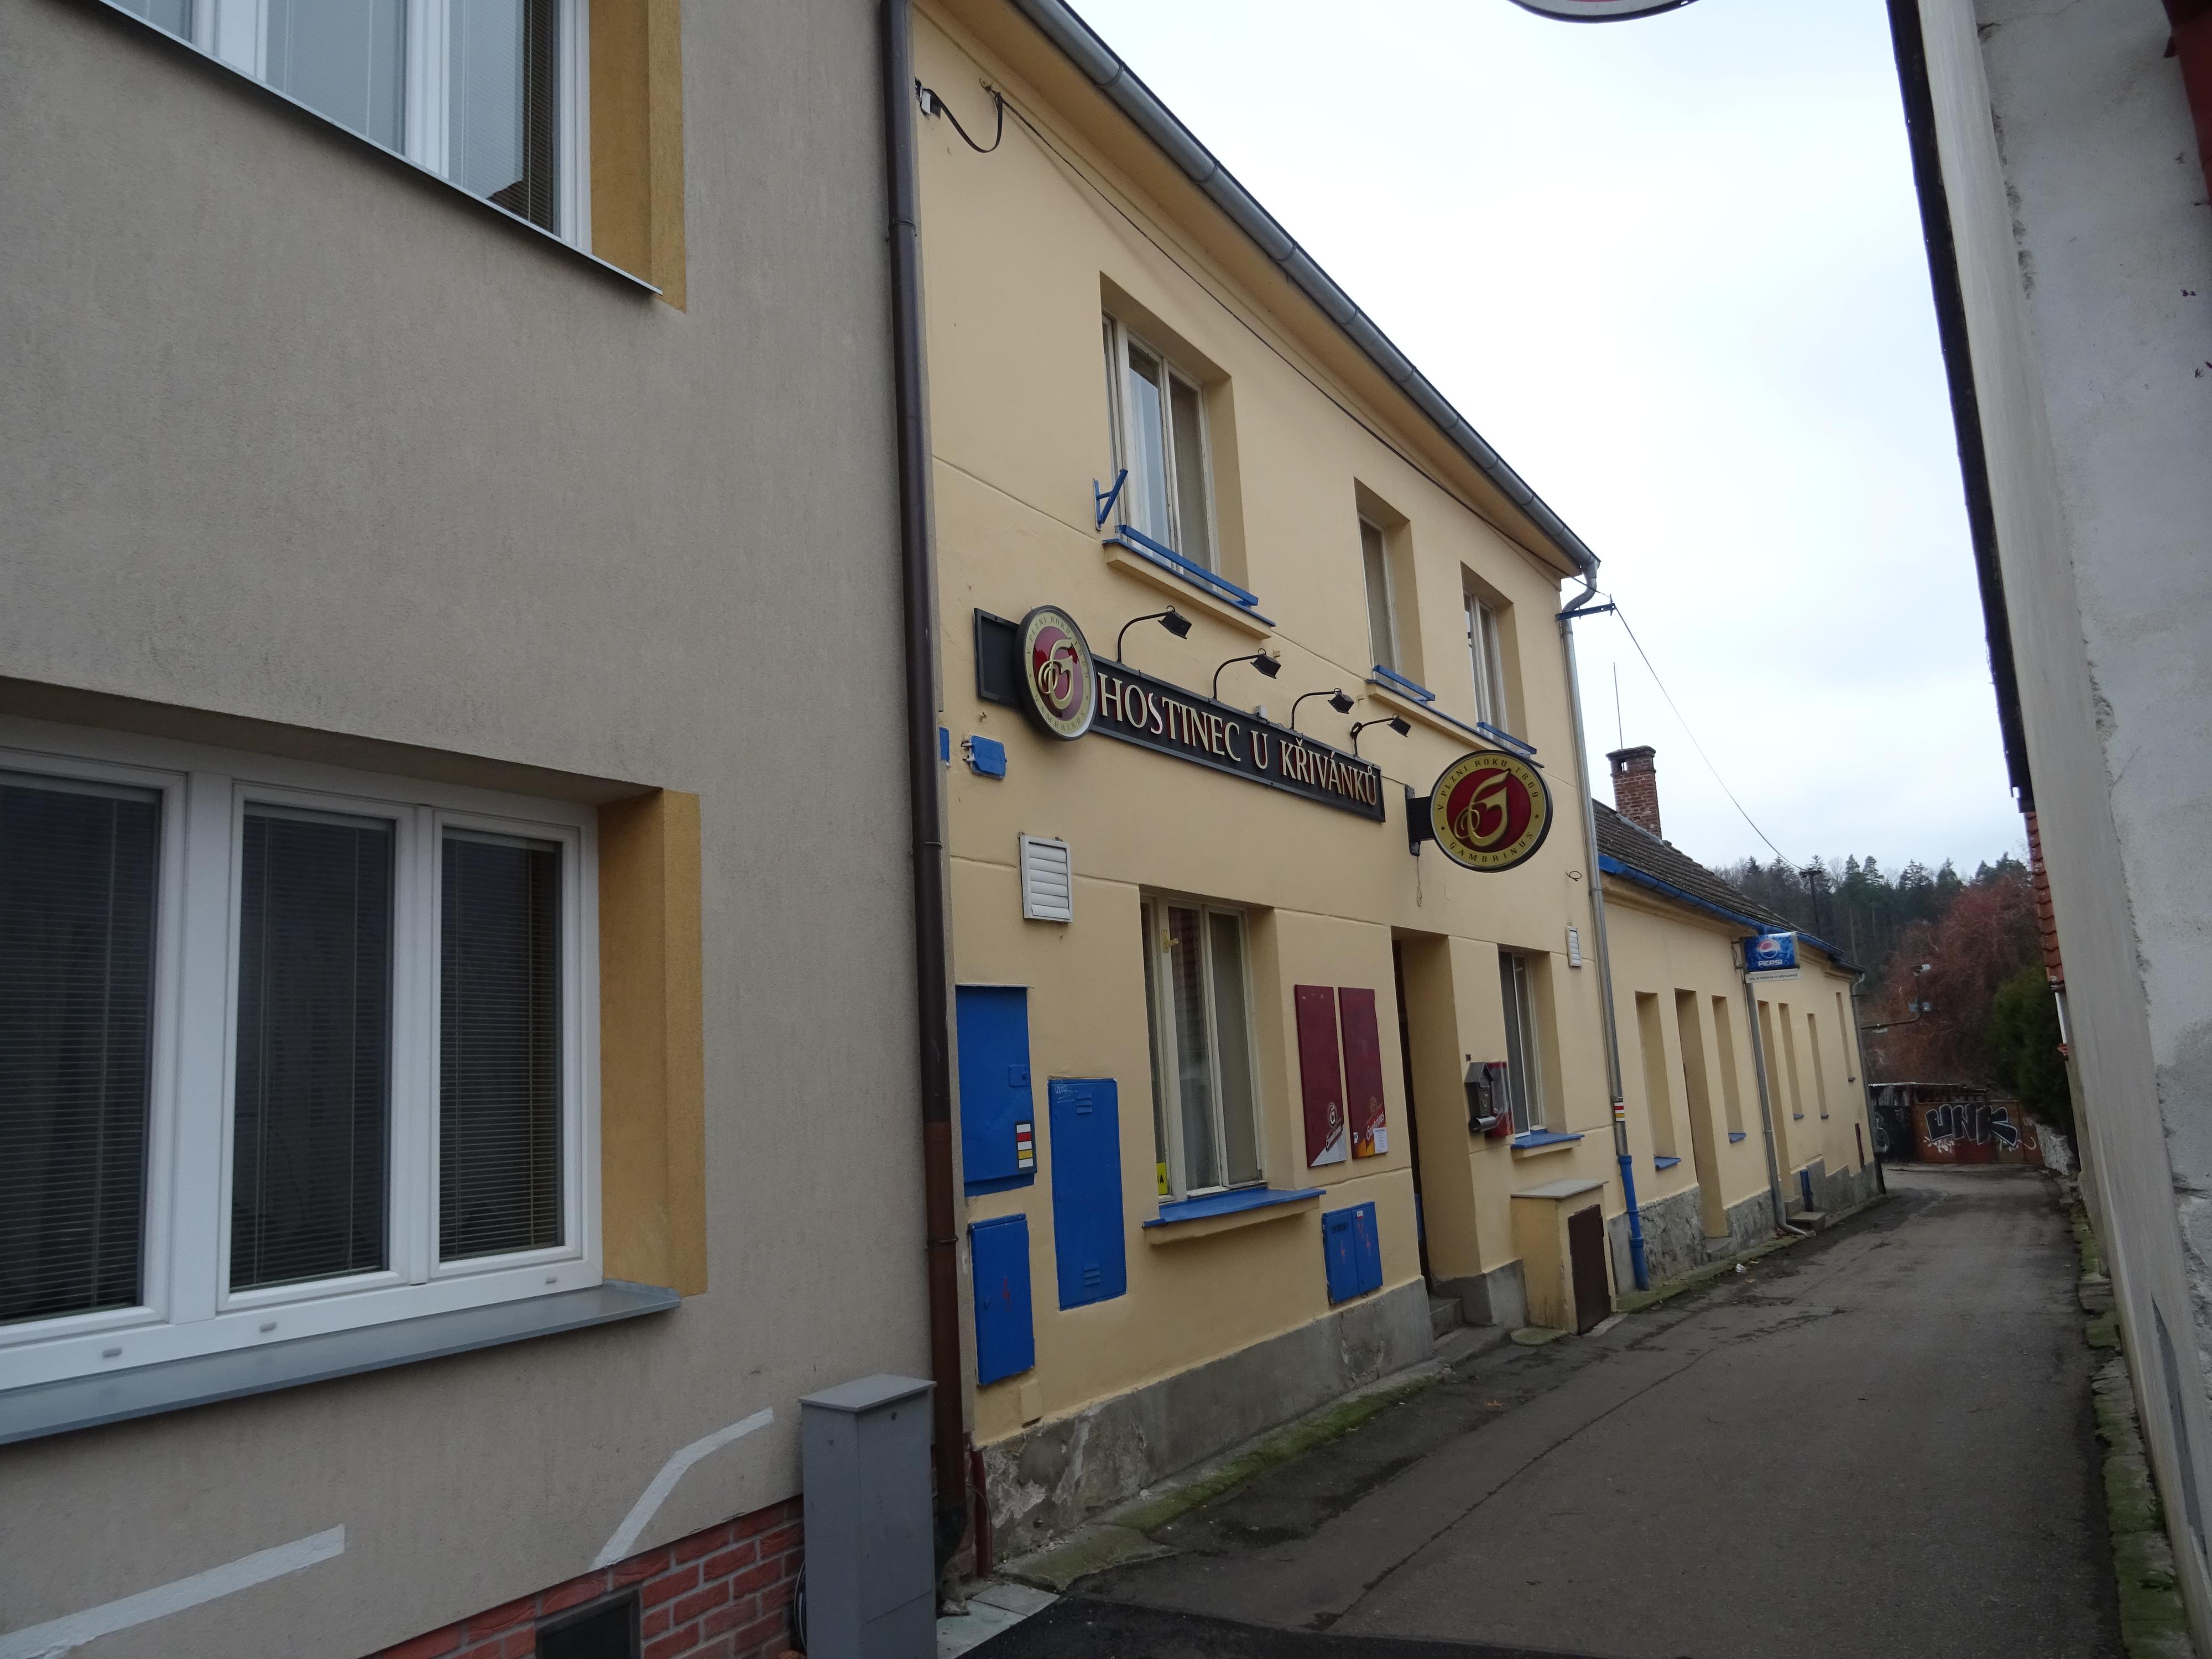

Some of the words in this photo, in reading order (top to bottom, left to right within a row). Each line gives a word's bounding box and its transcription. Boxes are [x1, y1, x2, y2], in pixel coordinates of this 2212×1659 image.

[1050, 616, 1071, 634] ROKU
[1035, 695, 1086, 731] GAMBRINUS
[1097, 672, 1241, 761] HOSTINEC
[1250, 729, 1268, 769] U
[1280, 738, 1377, 806] KŘIVÁNKŮ
[1441, 765, 1468, 797] PLZNI
[1474, 758, 1507, 768] ROKU
[1515, 766, 1539, 798] 1869
[1449, 831, 1533, 863] GAMBRINUS
